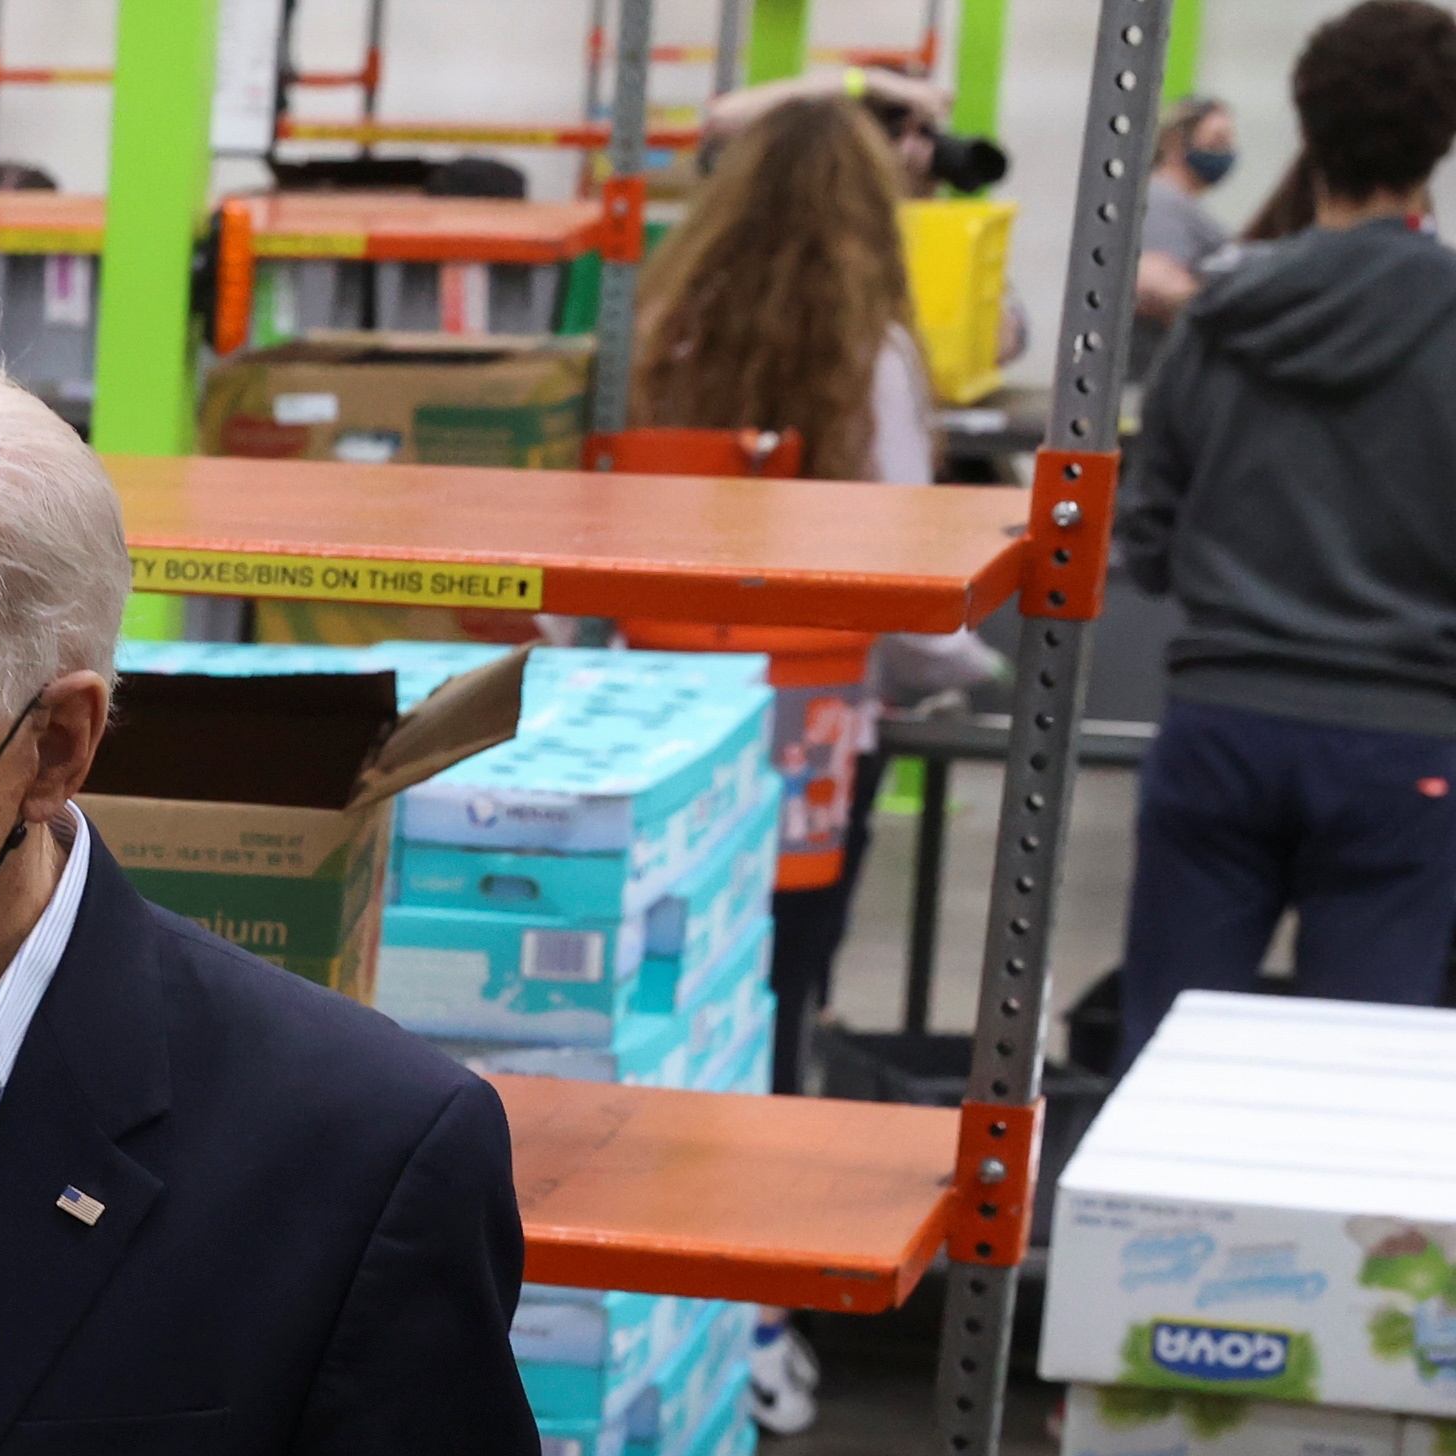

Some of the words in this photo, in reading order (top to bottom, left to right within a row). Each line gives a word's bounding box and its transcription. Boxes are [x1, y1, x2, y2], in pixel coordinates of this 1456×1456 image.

[165, 559, 313, 588] BOXES/BINS
[322, 568, 359, 590] ON
[369, 571, 422, 593] THIS
[430, 572, 513, 598] SHELF
[1154, 1326, 1285, 1370] GOYA
